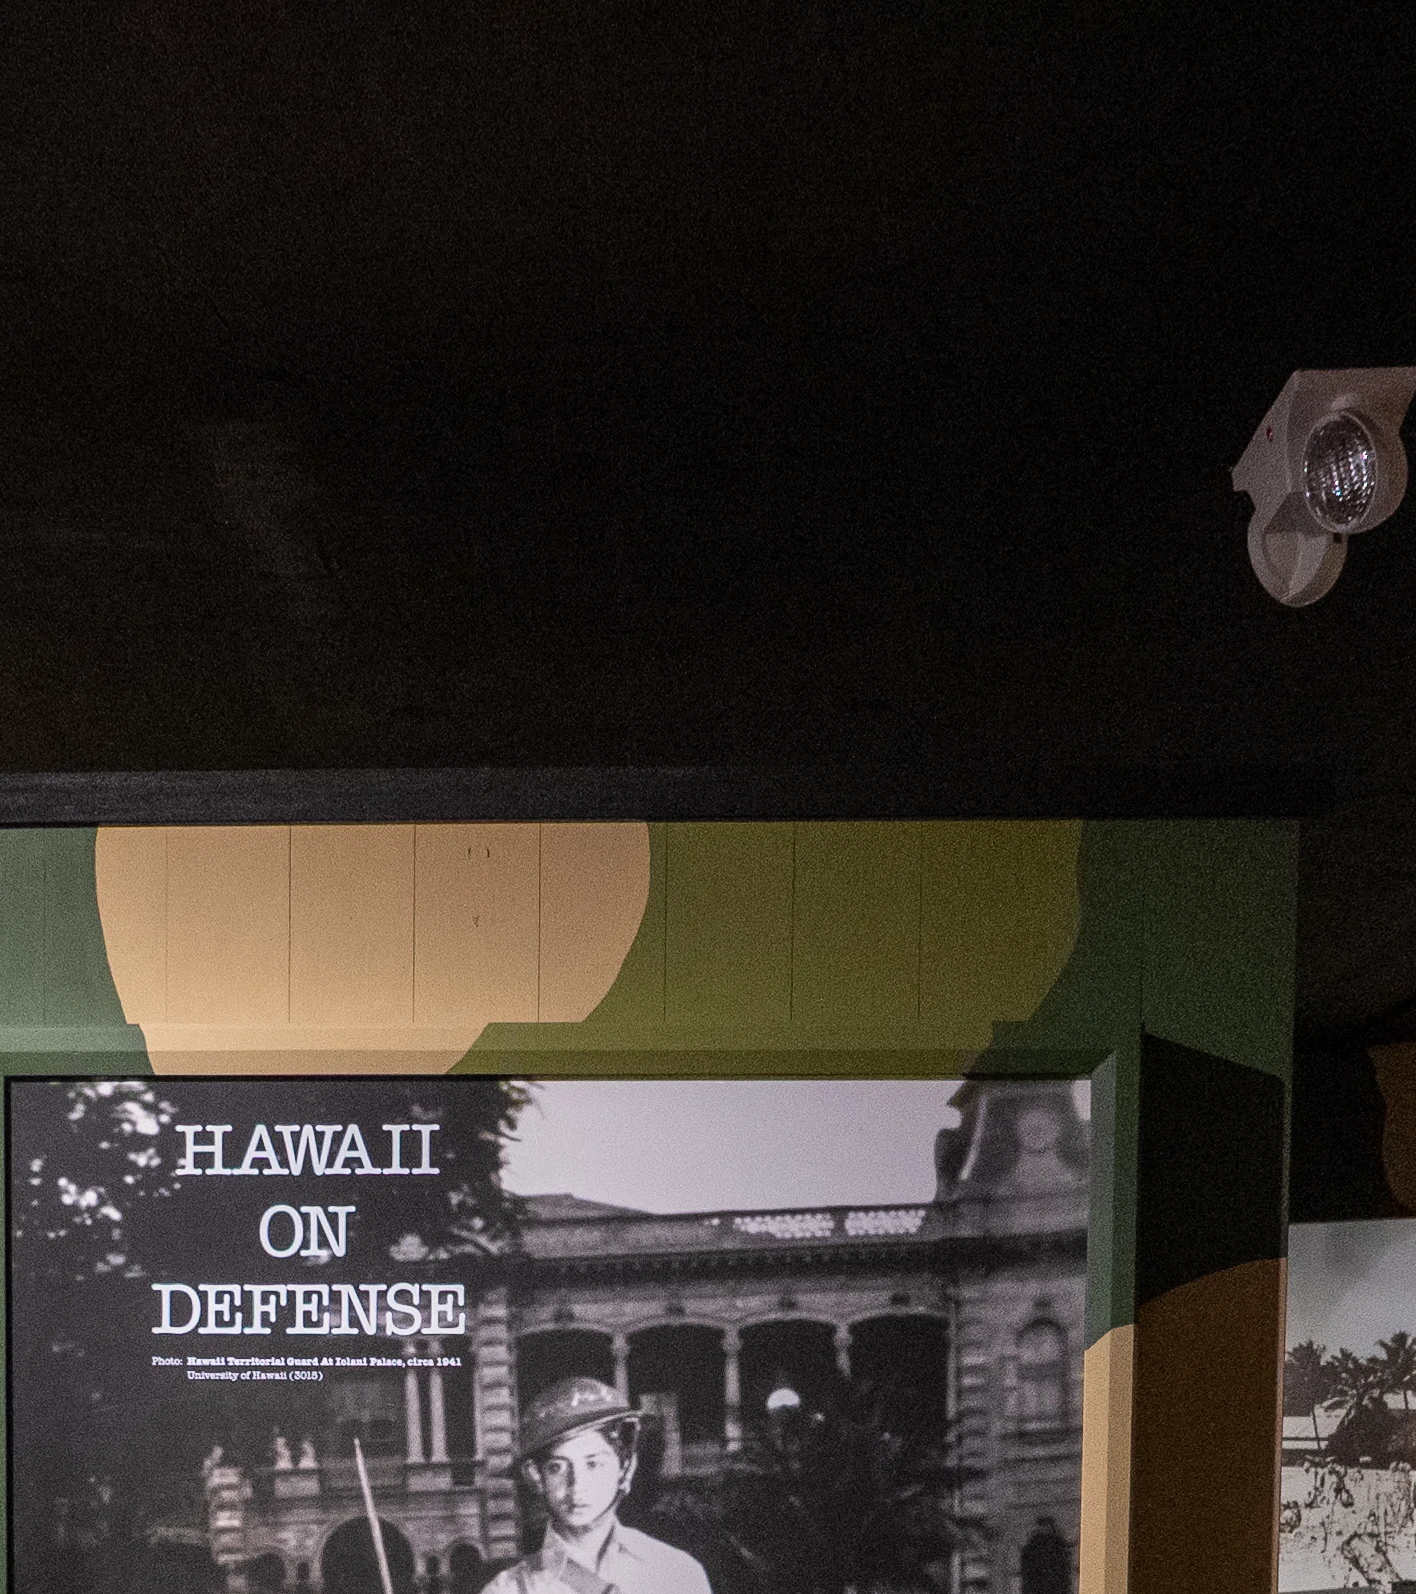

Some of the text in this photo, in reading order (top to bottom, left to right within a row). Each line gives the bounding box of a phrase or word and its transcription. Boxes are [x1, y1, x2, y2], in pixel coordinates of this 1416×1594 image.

[175, 1124, 440, 1176] HAWAII
[259, 1204, 356, 1261] ON
[151, 1282, 466, 1336] DEFENSE
[151, 1356, 462, 1368] Photo: Hawaii Territorial Guard At Iolani Palace, circa 1941
[186, 1370, 239, 1382] University
[240, 1370, 251, 1380] of
[252, 1370, 288, 1380] Hawaii
